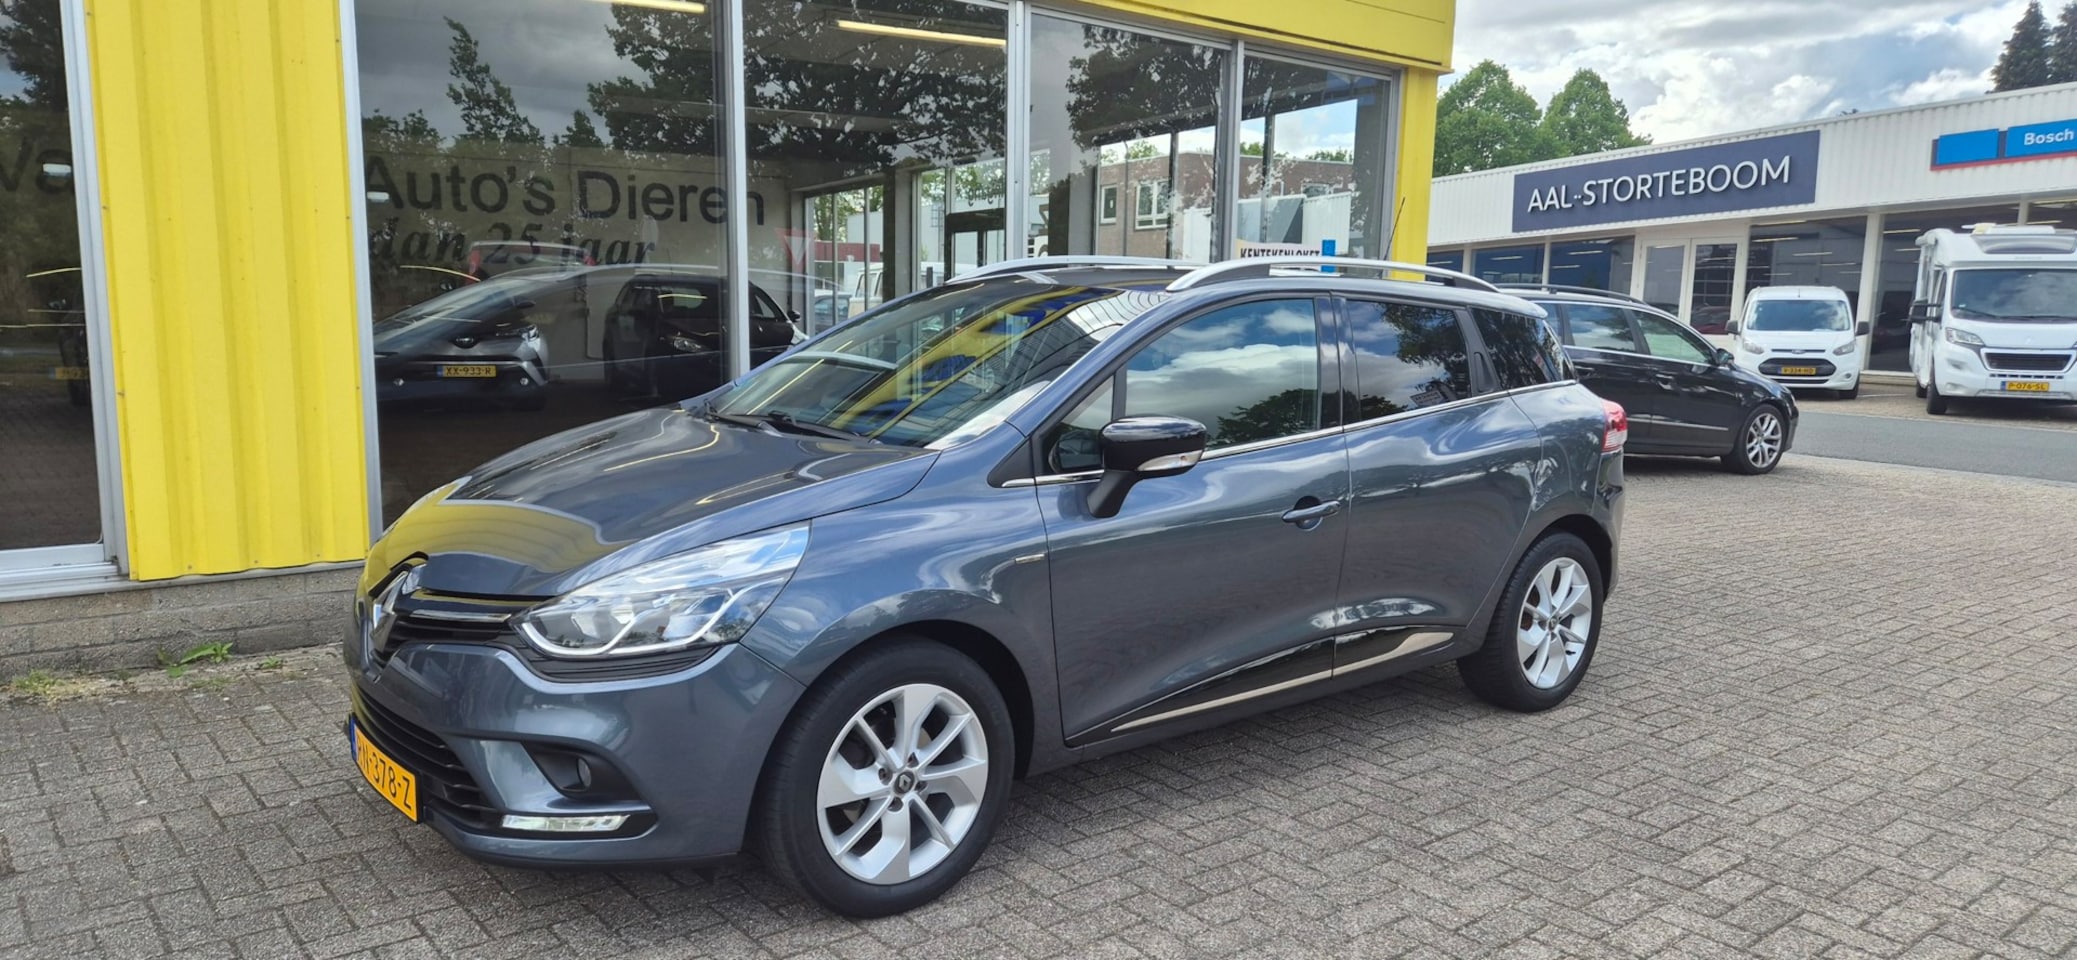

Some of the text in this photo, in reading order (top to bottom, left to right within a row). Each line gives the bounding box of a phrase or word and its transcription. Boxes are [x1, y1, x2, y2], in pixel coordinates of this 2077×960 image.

[2024, 128, 2074, 146] Bosch
[366, 154, 765, 226] Auto's Dieren
[483, 222, 543, 264] 25
